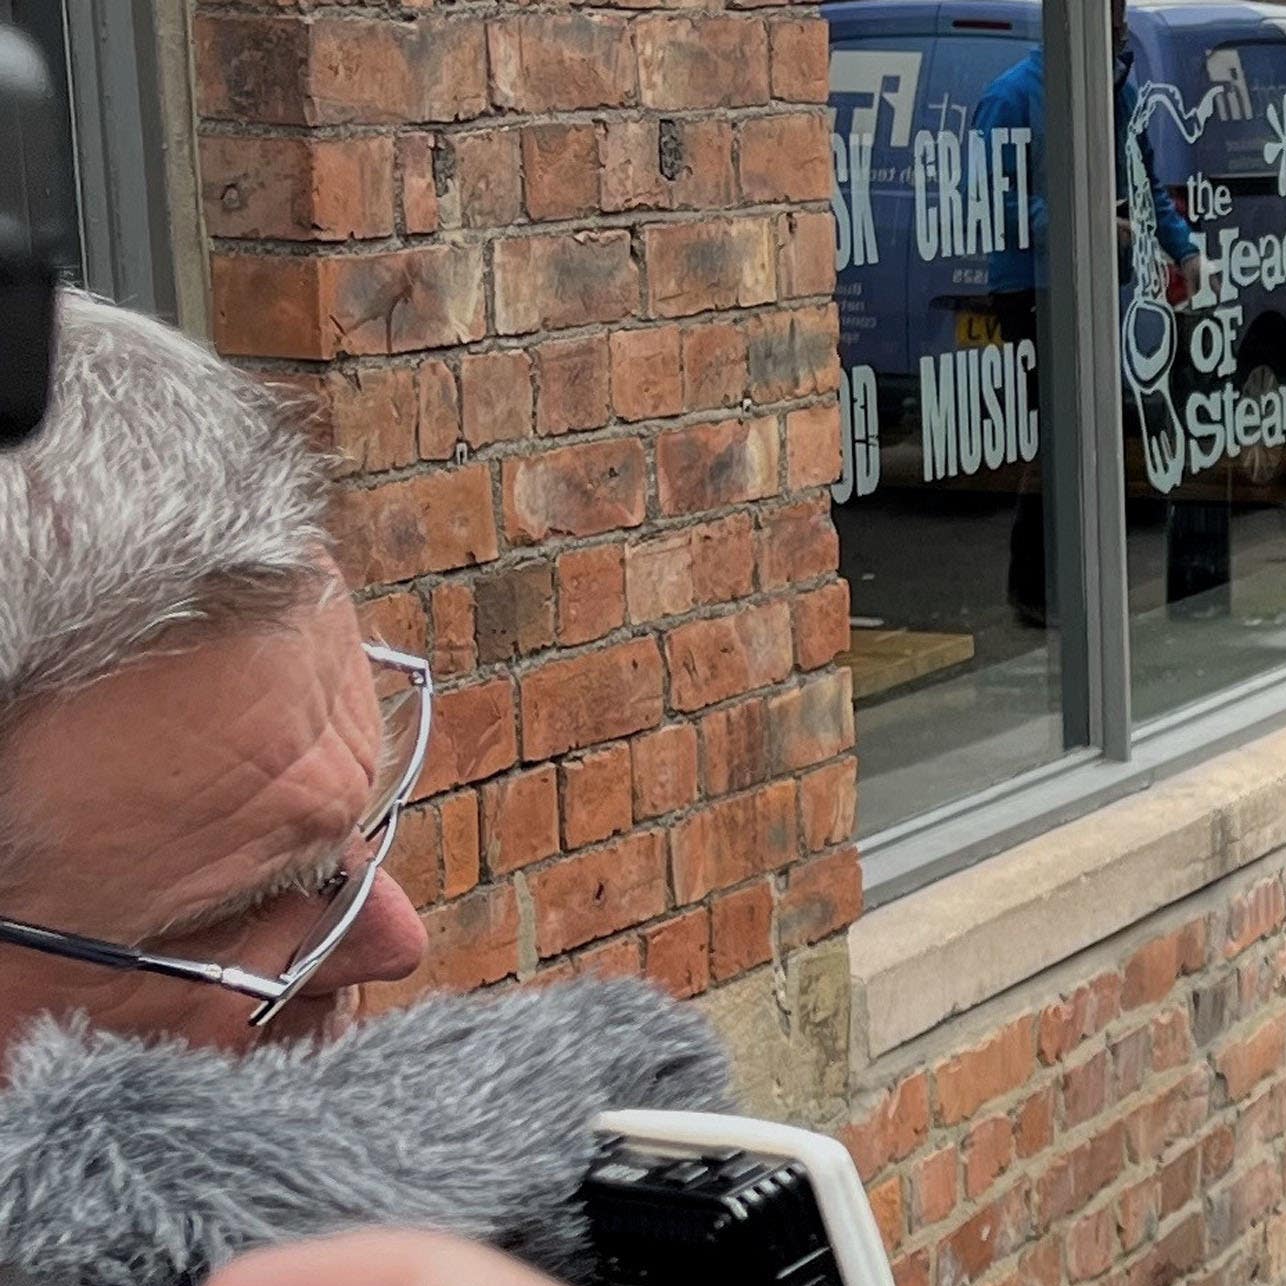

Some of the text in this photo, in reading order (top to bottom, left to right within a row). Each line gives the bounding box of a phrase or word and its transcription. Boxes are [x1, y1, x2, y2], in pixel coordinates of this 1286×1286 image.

[914, 127, 1032, 262] CRAFT
[1187, 172, 1233, 223] the
[920, 338, 1039, 483] MUSIC
